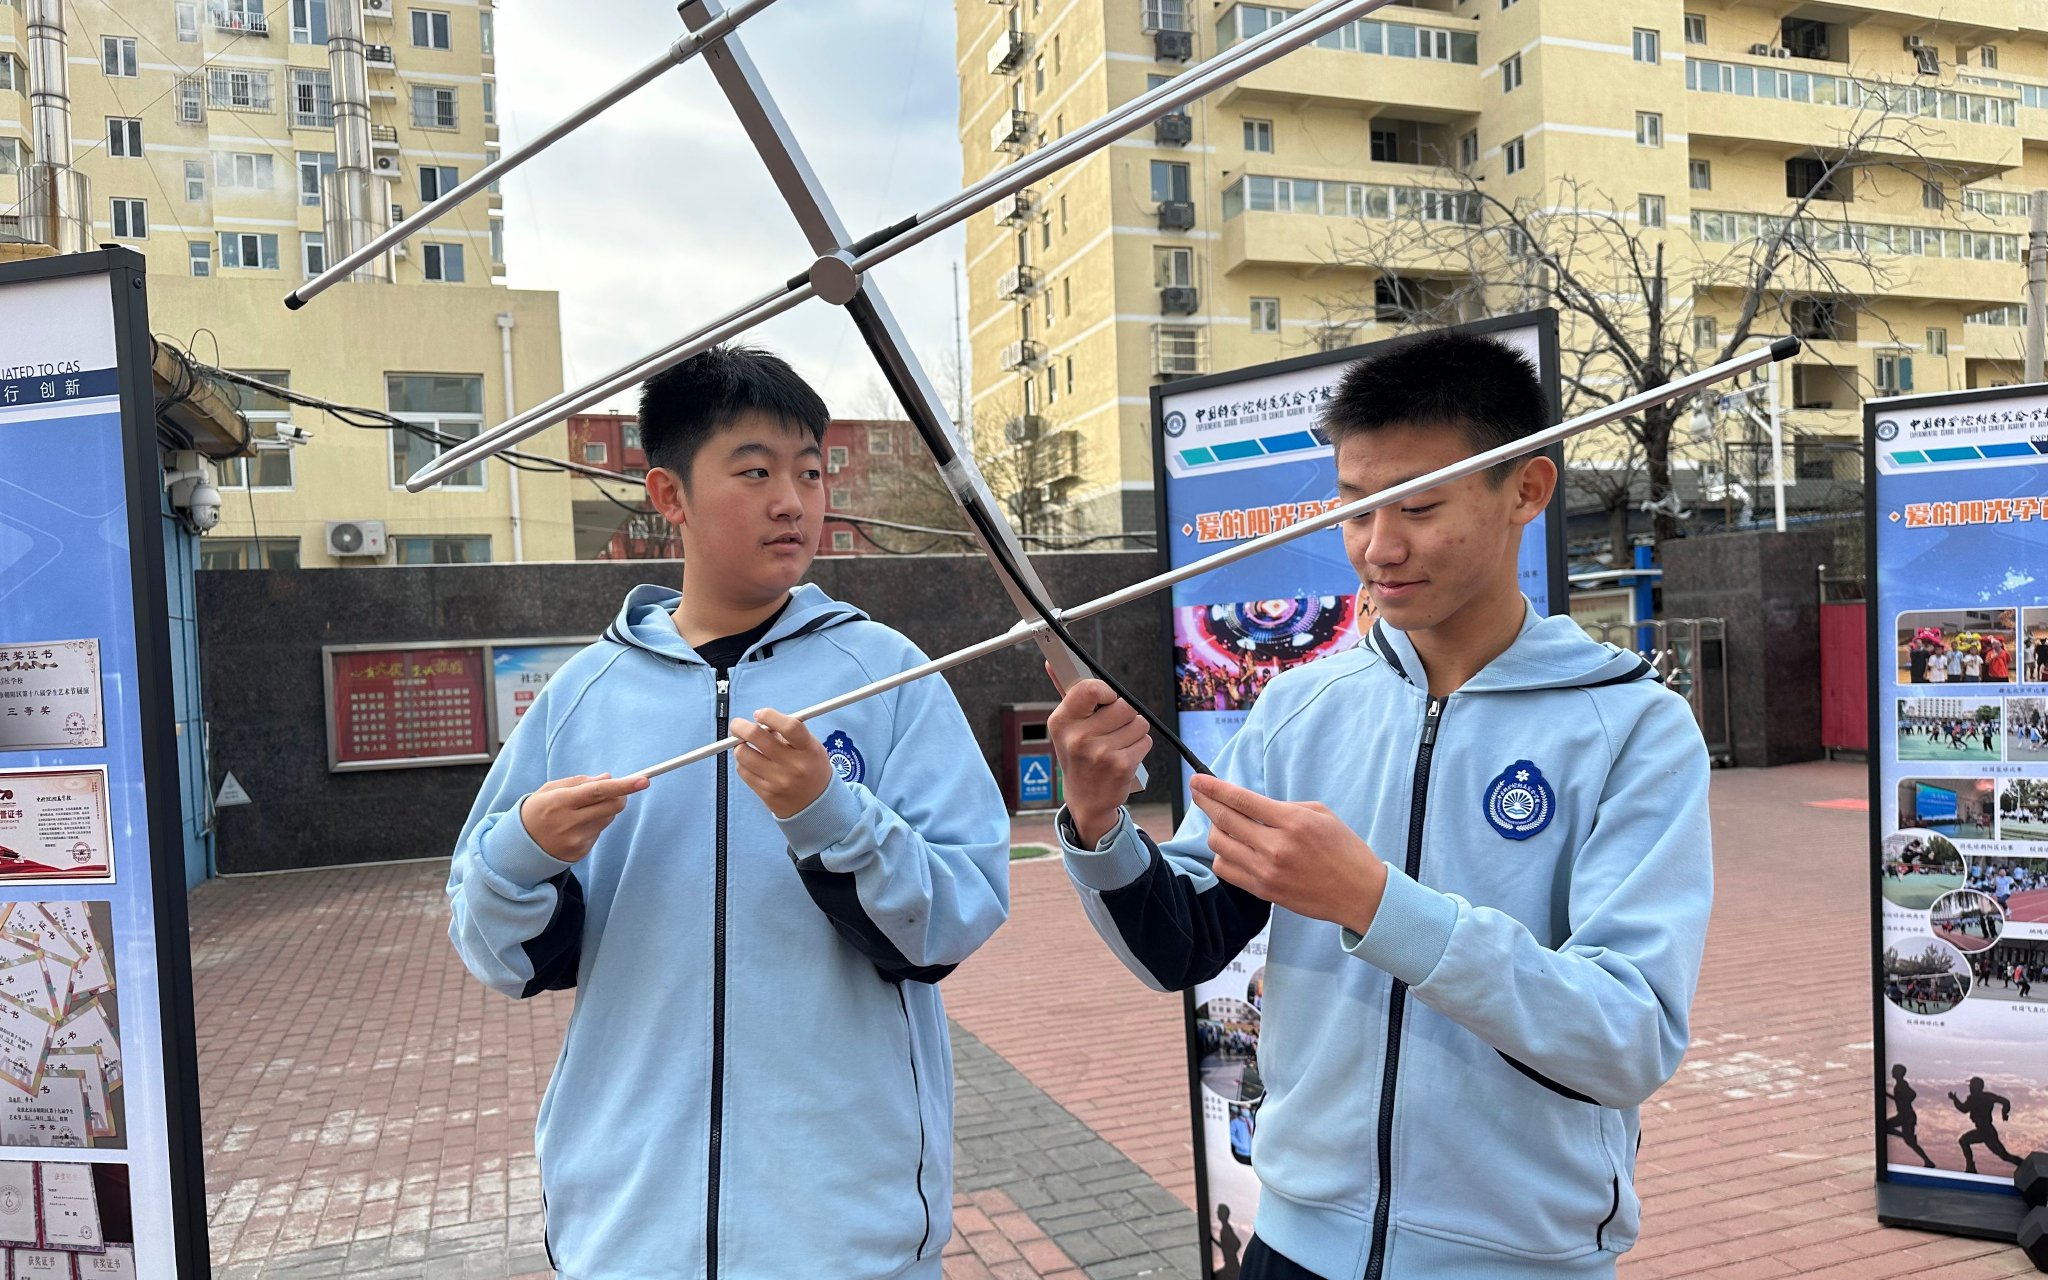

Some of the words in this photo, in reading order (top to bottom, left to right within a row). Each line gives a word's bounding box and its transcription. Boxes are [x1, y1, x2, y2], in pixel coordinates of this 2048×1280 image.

[37, 363, 54, 376] TO
[57, 360, 80, 374] CAS
[4, 385, 19, 402] 行
[40, 379, 80, 398] 创新
[0, 649, 53, 661] 获奖证书
